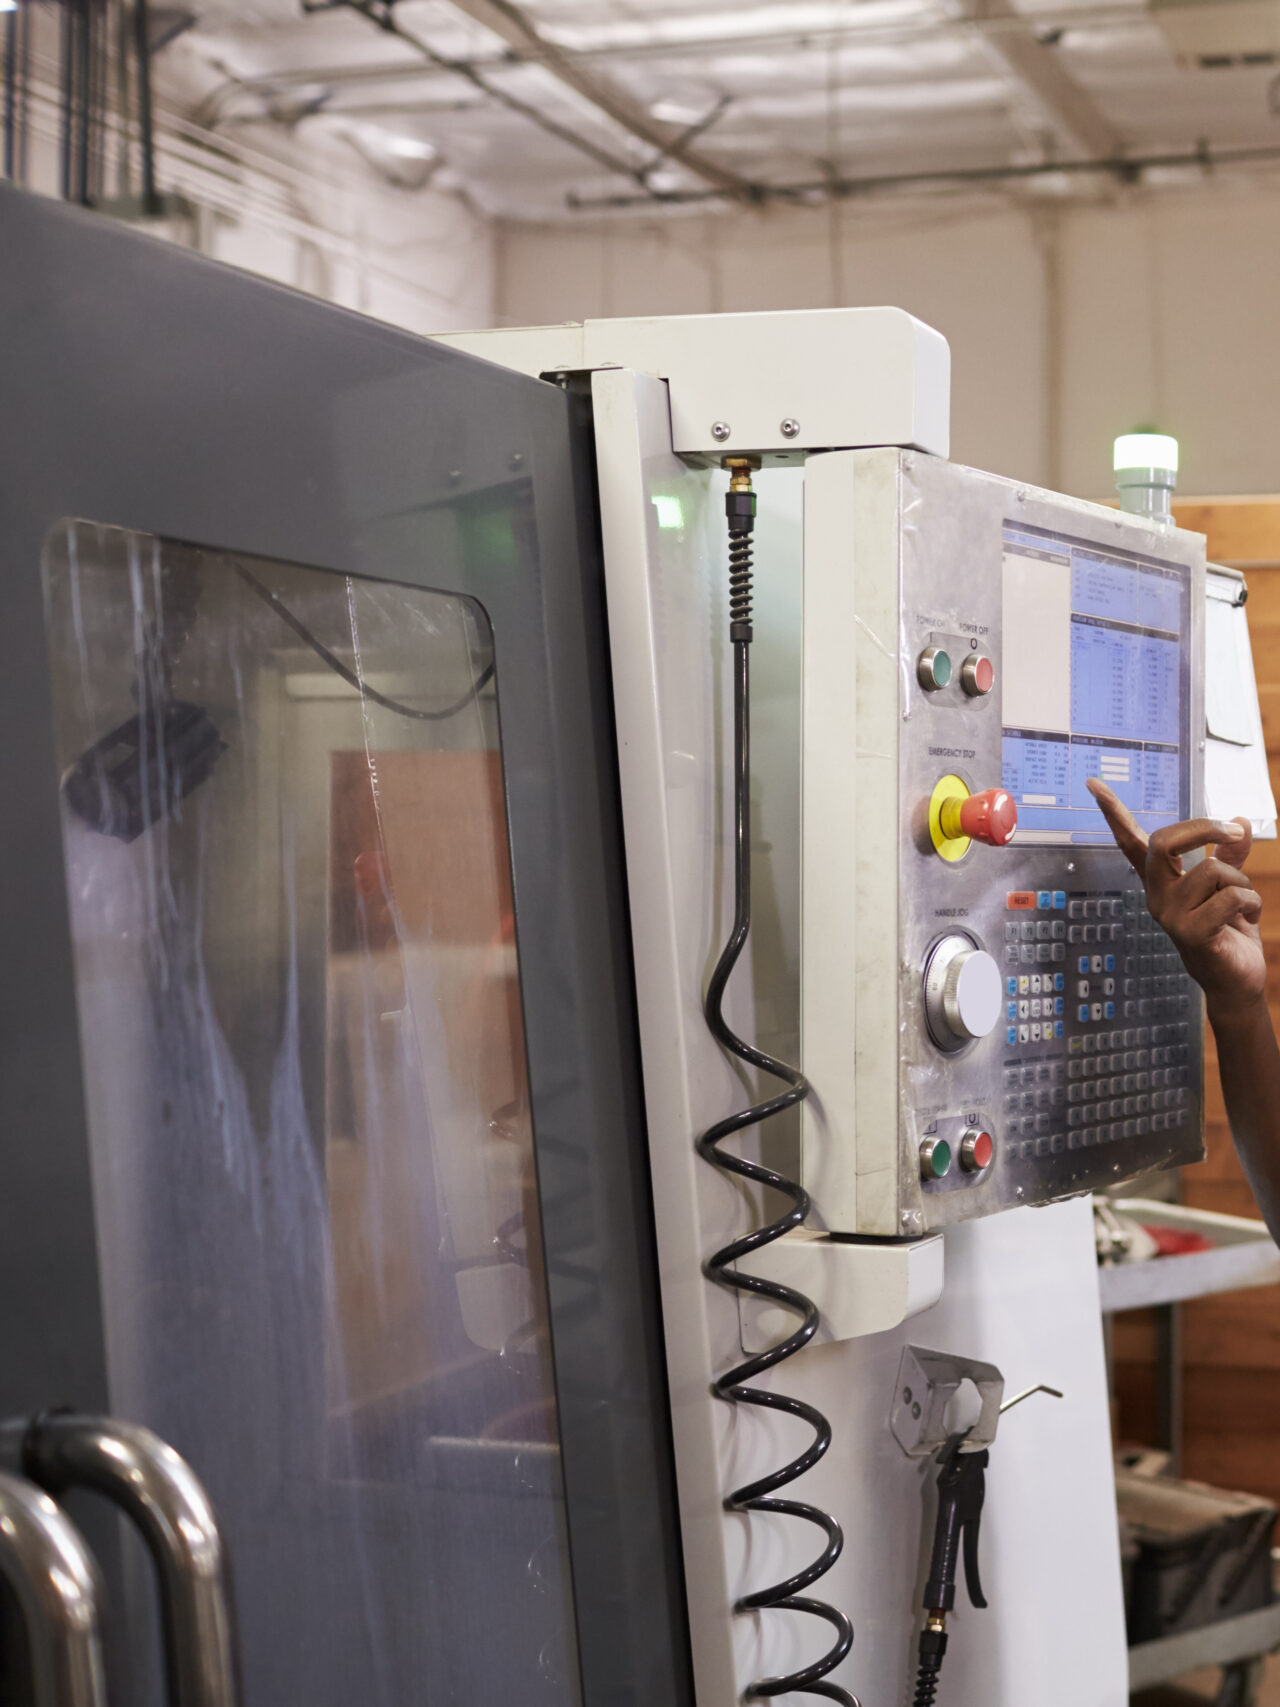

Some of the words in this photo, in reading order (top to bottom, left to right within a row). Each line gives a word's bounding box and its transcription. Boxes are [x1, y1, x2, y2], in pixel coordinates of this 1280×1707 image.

[959, 622, 978, 635] POWER
[979, 625, 989, 635] OFF
[928, 746, 962, 757] EMERGENCY
[963, 749, 976, 759] STOP
[1014, 896, 1029, 905] RESET
[934, 908, 956, 917] HANDLE
[956, 907, 969, 917] JOG
